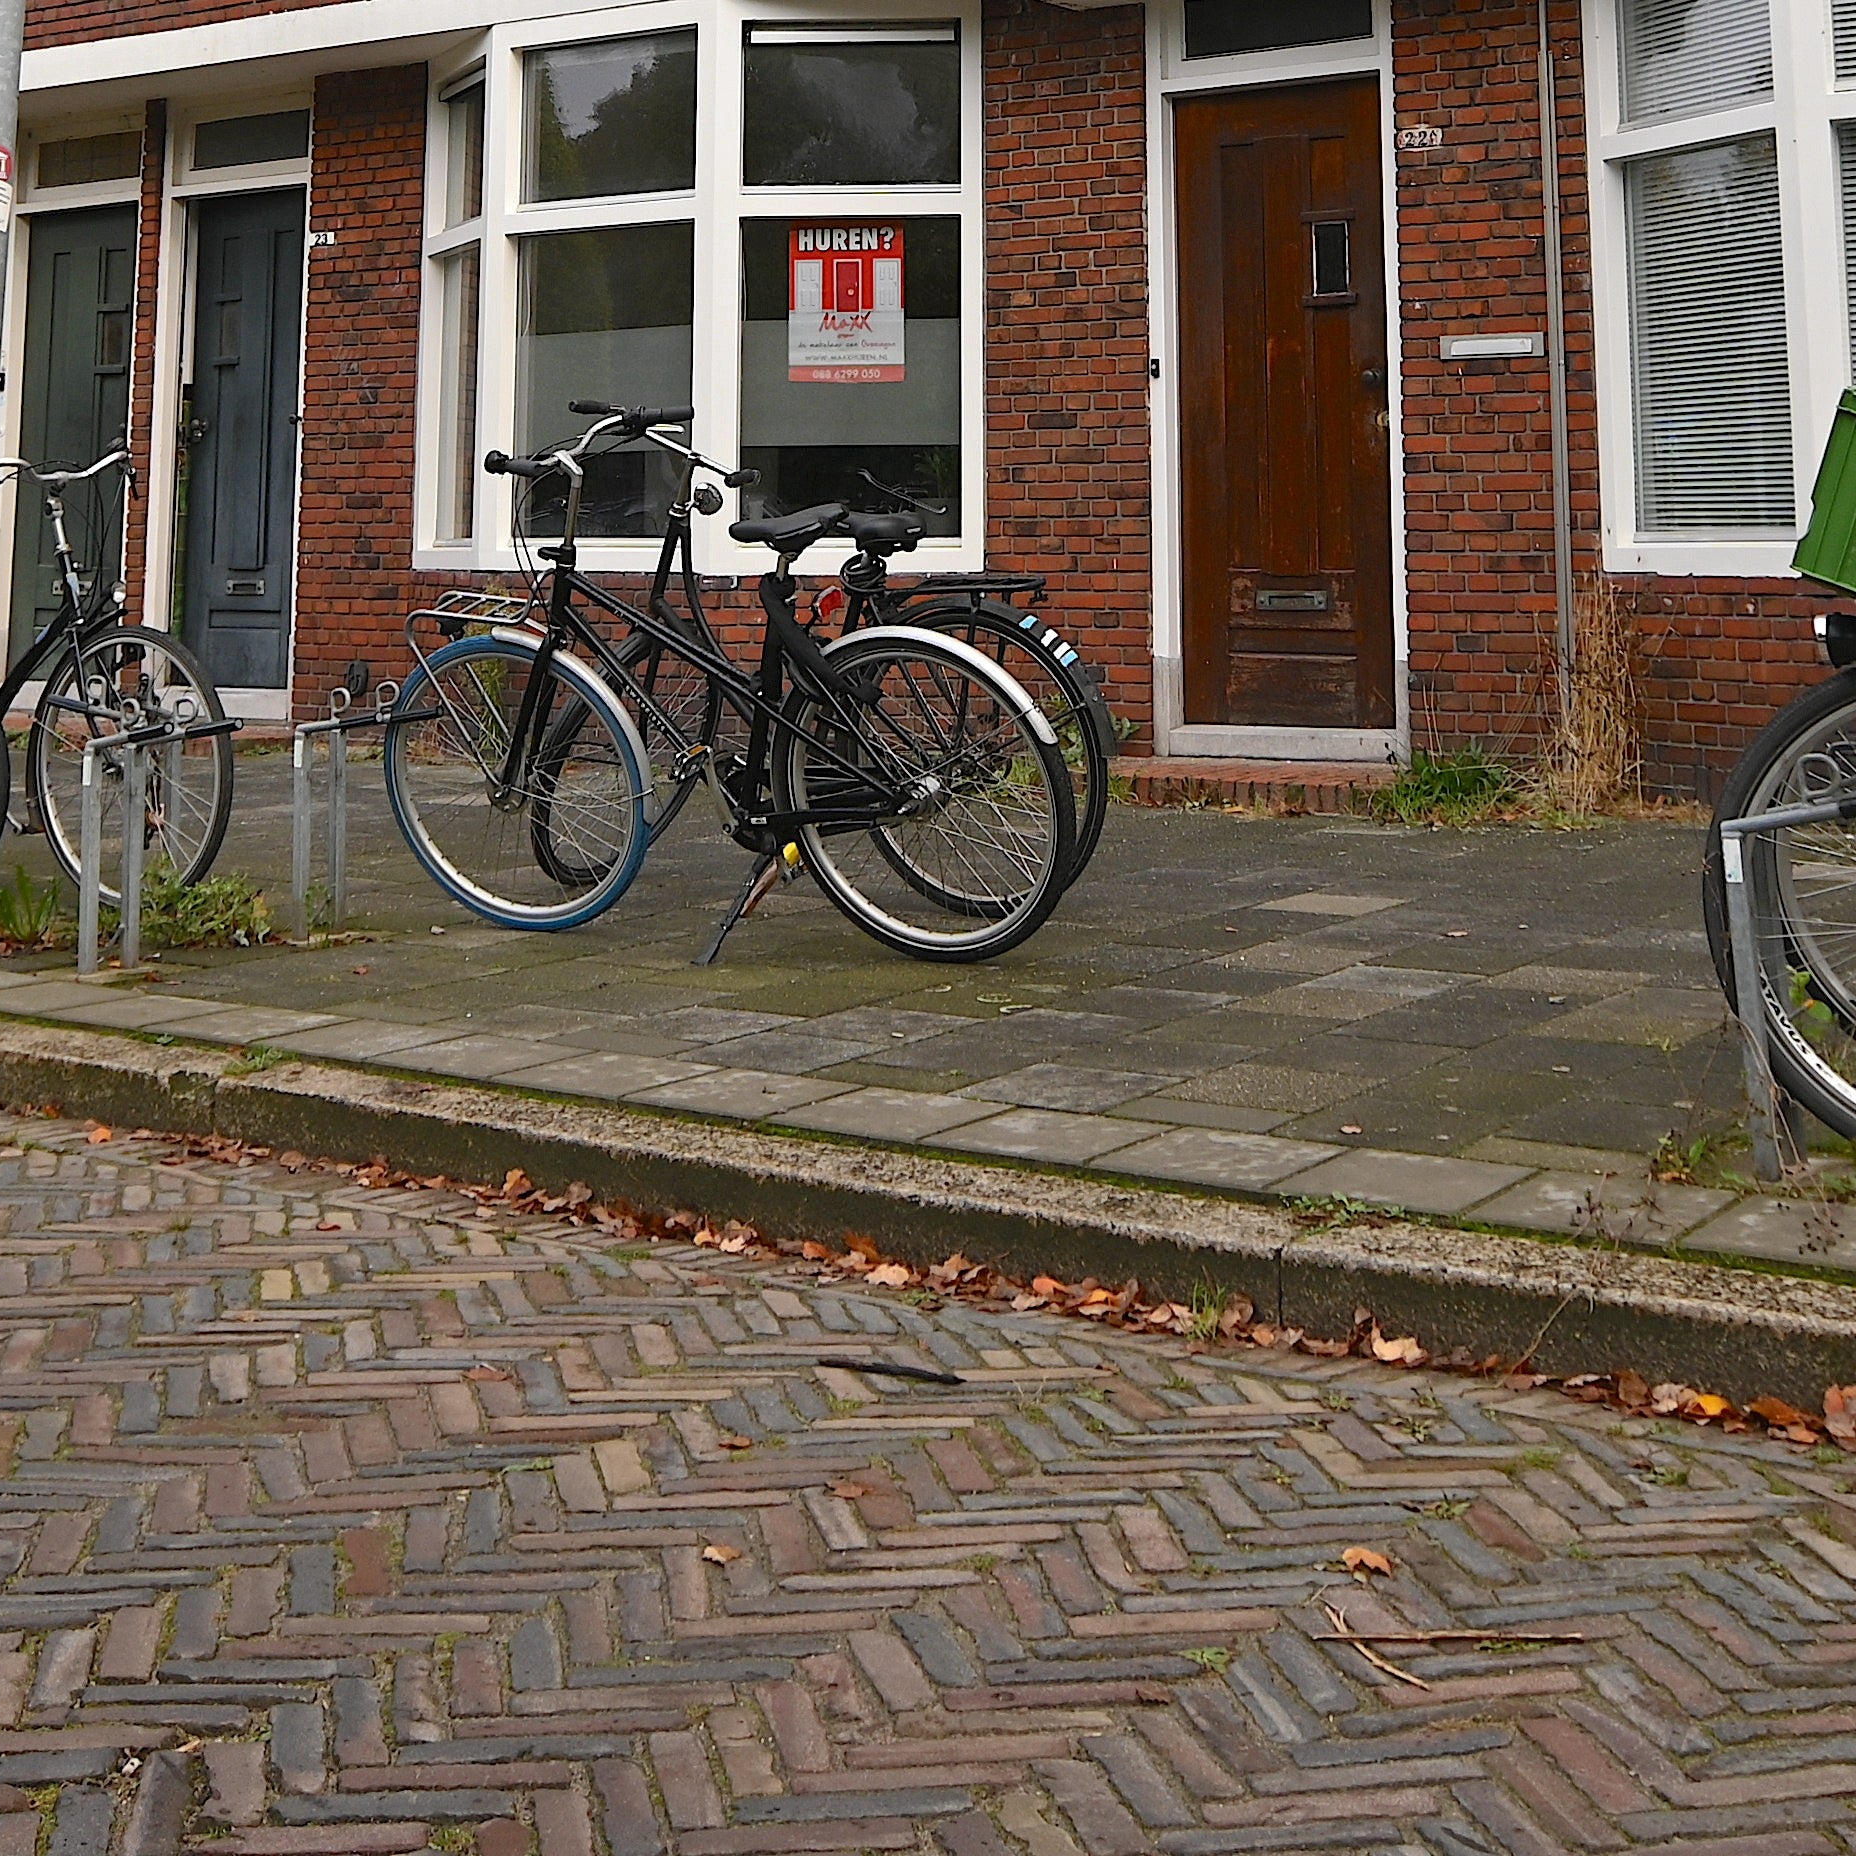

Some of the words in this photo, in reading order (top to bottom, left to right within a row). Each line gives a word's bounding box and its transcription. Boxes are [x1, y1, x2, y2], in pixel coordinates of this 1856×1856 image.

[315, 233, 328, 246] 23
[797, 226, 895, 252] HUREN?
[834, 369, 859, 379] 6299
[861, 369, 881, 379] 050
